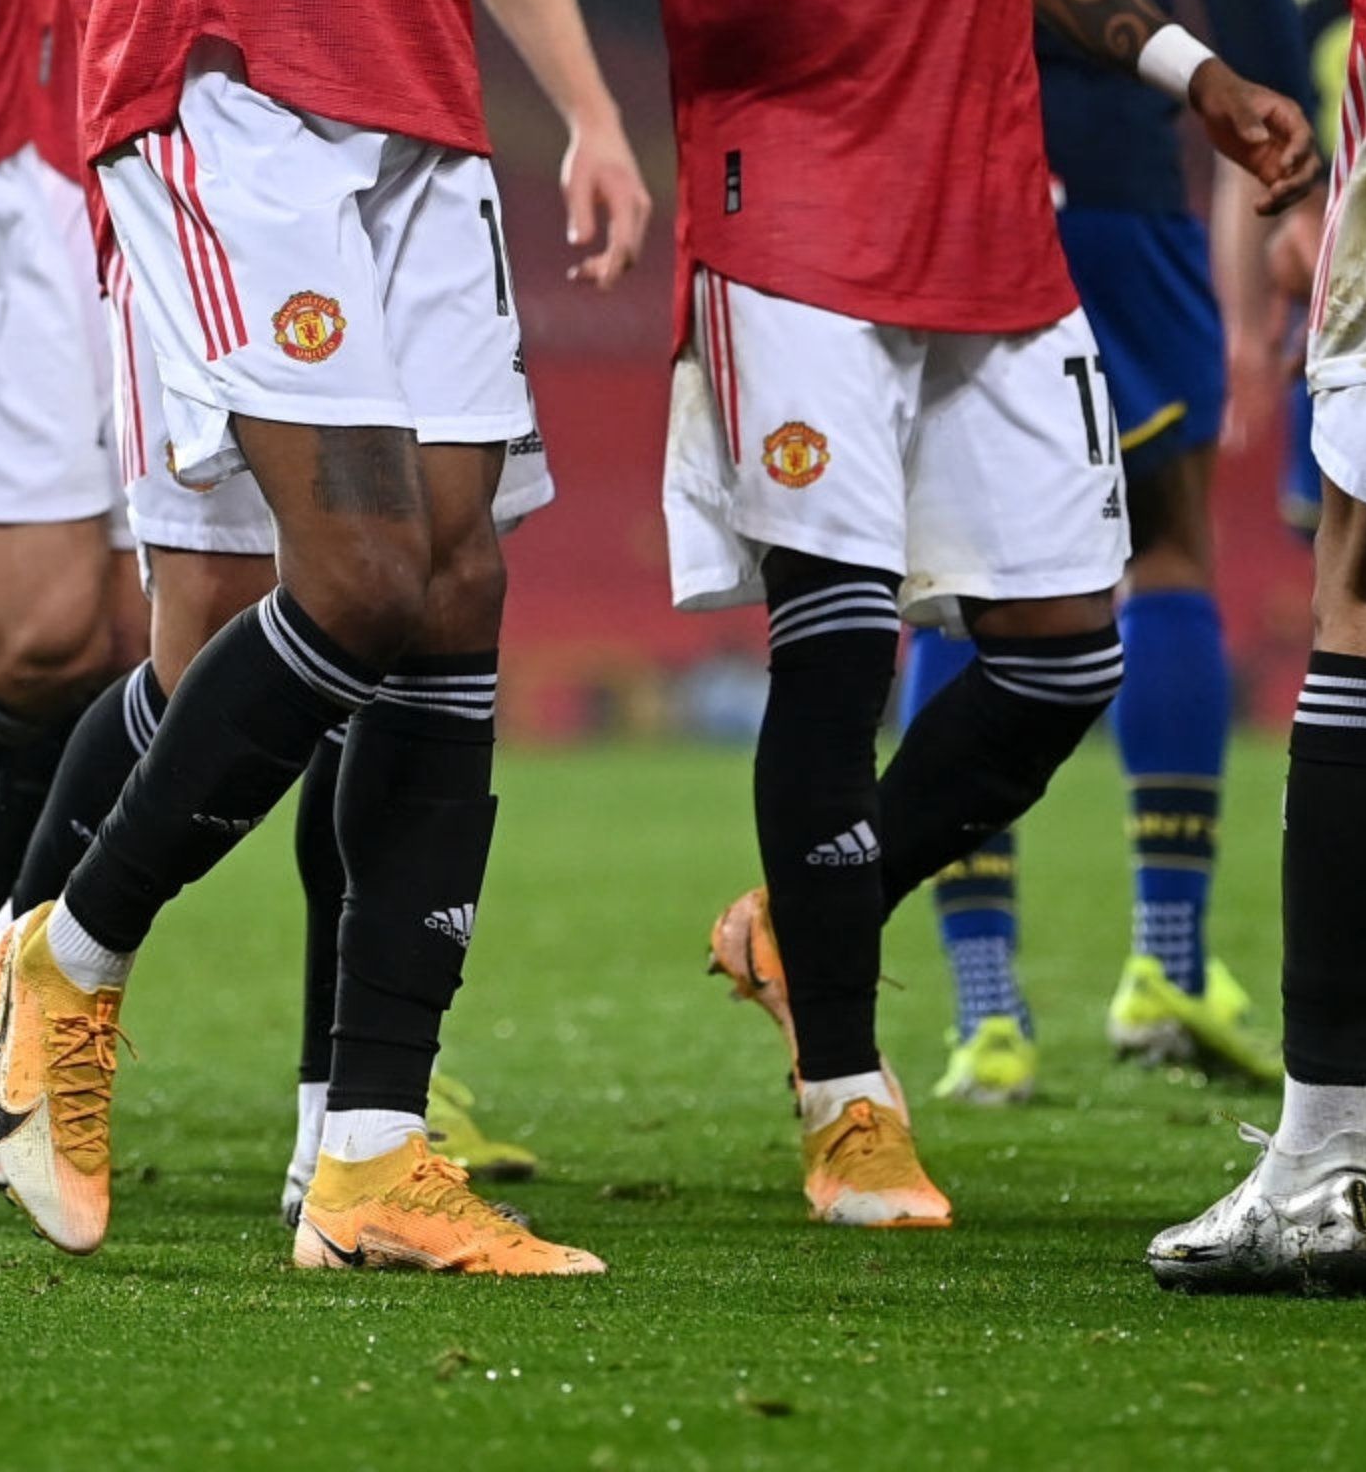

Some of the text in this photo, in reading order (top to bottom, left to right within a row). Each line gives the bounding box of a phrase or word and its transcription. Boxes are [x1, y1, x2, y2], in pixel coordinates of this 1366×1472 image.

[479, 199, 514, 316] 1
[806, 845, 881, 866] adida
[424, 916, 471, 948] adid
